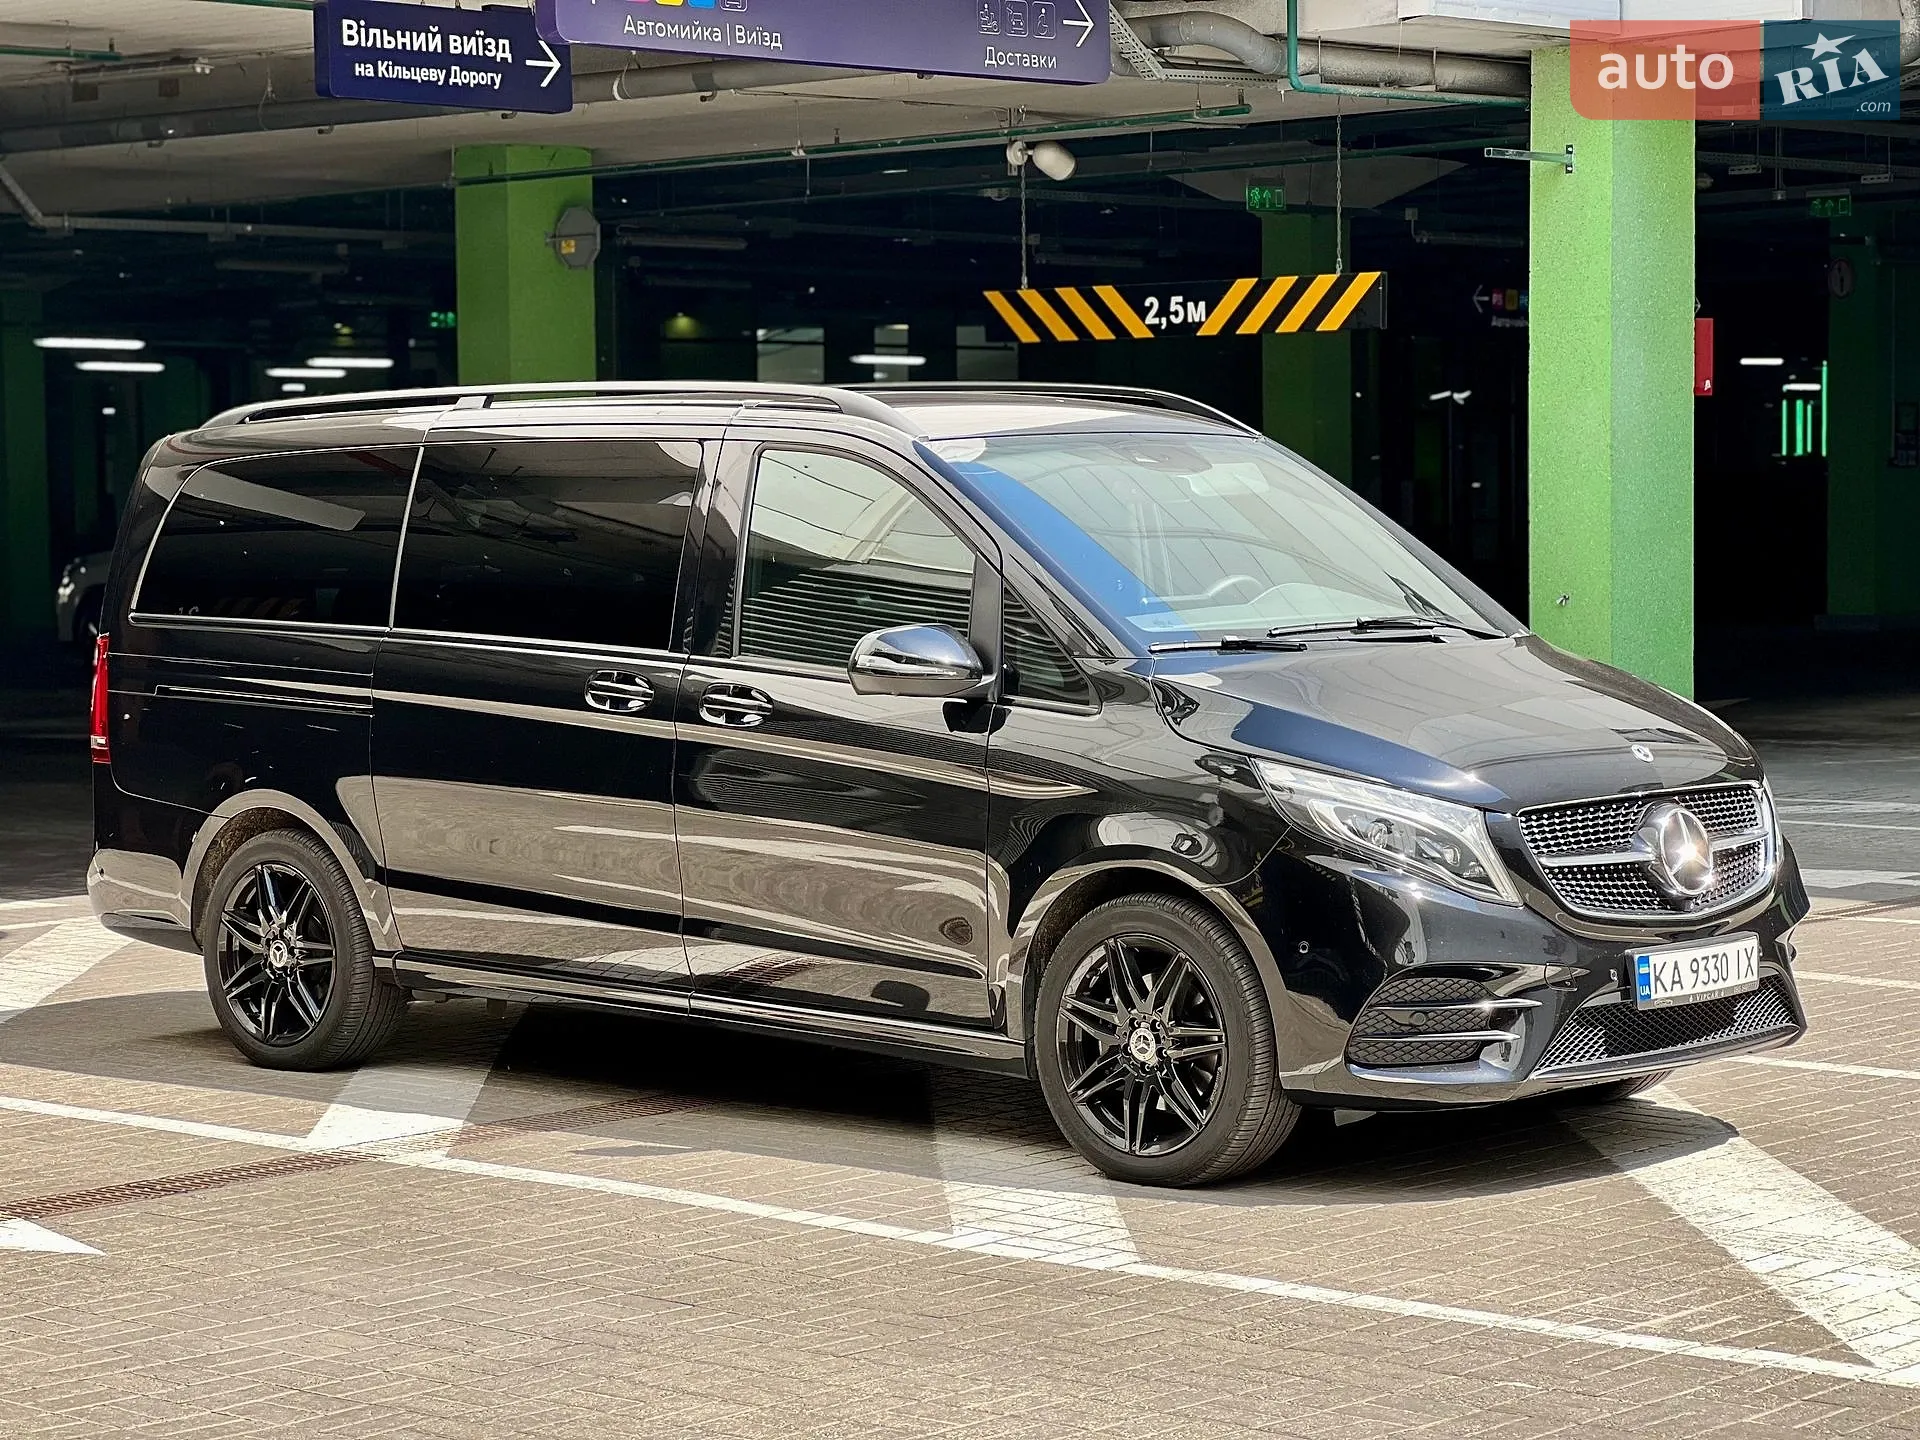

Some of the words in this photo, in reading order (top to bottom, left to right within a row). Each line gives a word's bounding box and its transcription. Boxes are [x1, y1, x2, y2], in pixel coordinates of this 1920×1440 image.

[341, 18, 442, 55] Вільний
[448, 33, 512, 63] виїзд
[623, 14, 722, 43] Автомийка
[735, 25, 783, 50] Виїзд
[984, 46, 1058, 69] Доставки
[354, 62, 374, 78] на
[378, 64, 446, 86] Кільцеву
[449, 67, 502, 89] Дорогу
[1653, 960, 1684, 995] KA
[1690, 952, 1729, 990] 9330
[1736, 946, 1755, 981] IX
[1640, 985, 1650, 996] UA
